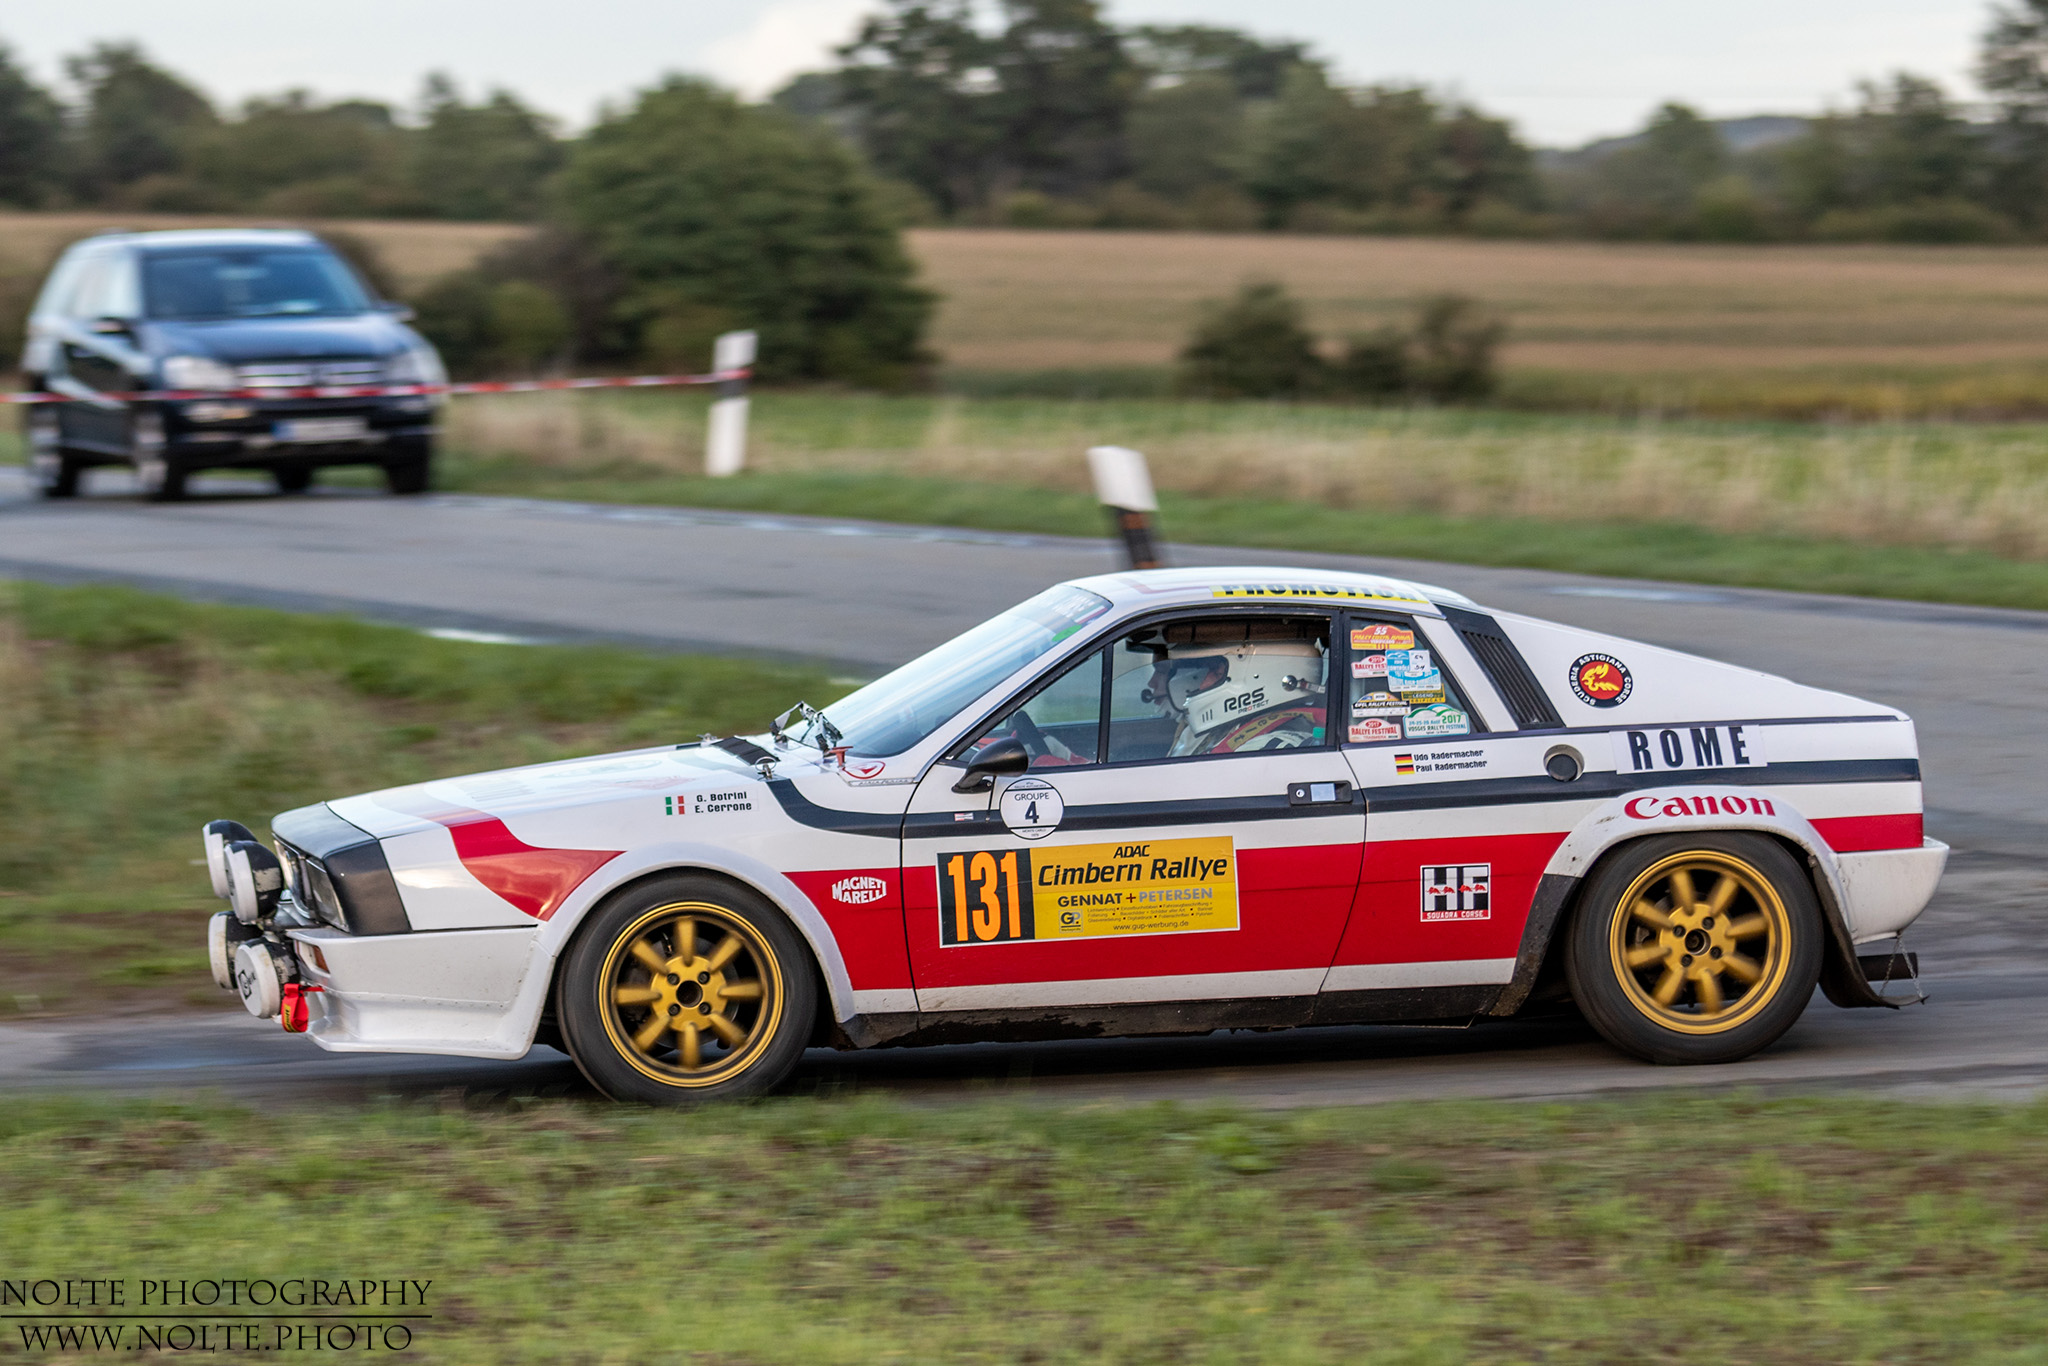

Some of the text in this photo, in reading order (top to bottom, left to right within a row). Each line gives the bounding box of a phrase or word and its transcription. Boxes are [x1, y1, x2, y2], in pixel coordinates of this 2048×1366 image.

[1578, 654, 1626, 673] ASTIGIANA
[1570, 666, 1596, 706] SCUDERIA
[1615, 676, 1631, 704] CORSE
[1224, 686, 1264, 712] RRS
[1238, 699, 1269, 714] PROTECT
[1442, 715, 1461, 724] 2017
[1372, 726, 1397, 734] FESTIVAL
[1431, 750, 1483, 760] Radermacher
[1627, 726, 1750, 770] ROME
[1416, 760, 1487, 772] Paul Radermacher
[696, 791, 747, 802] G. Botrini
[1014, 792, 1049, 801] GROUPE
[695, 802, 752, 813] E. Cerrone
[1025, 801, 1039, 823] 4
[1624, 795, 1776, 820] Canon
[1113, 845, 1150, 858] ADAC
[1038, 856, 1227, 886] Cimbern Rallye
[832, 876, 886, 893] MAGNETI
[1424, 866, 1488, 911] HF
[832, 886, 886, 904] MARELLI
[947, 851, 1021, 942] 131
[1058, 893, 1122, 907] GENNAT
[1139, 888, 1213, 902] PETERSEN
[1461, 910, 1484, 918] CORSE
[1113, 920, 1189, 930] www.gup-werbung.de
